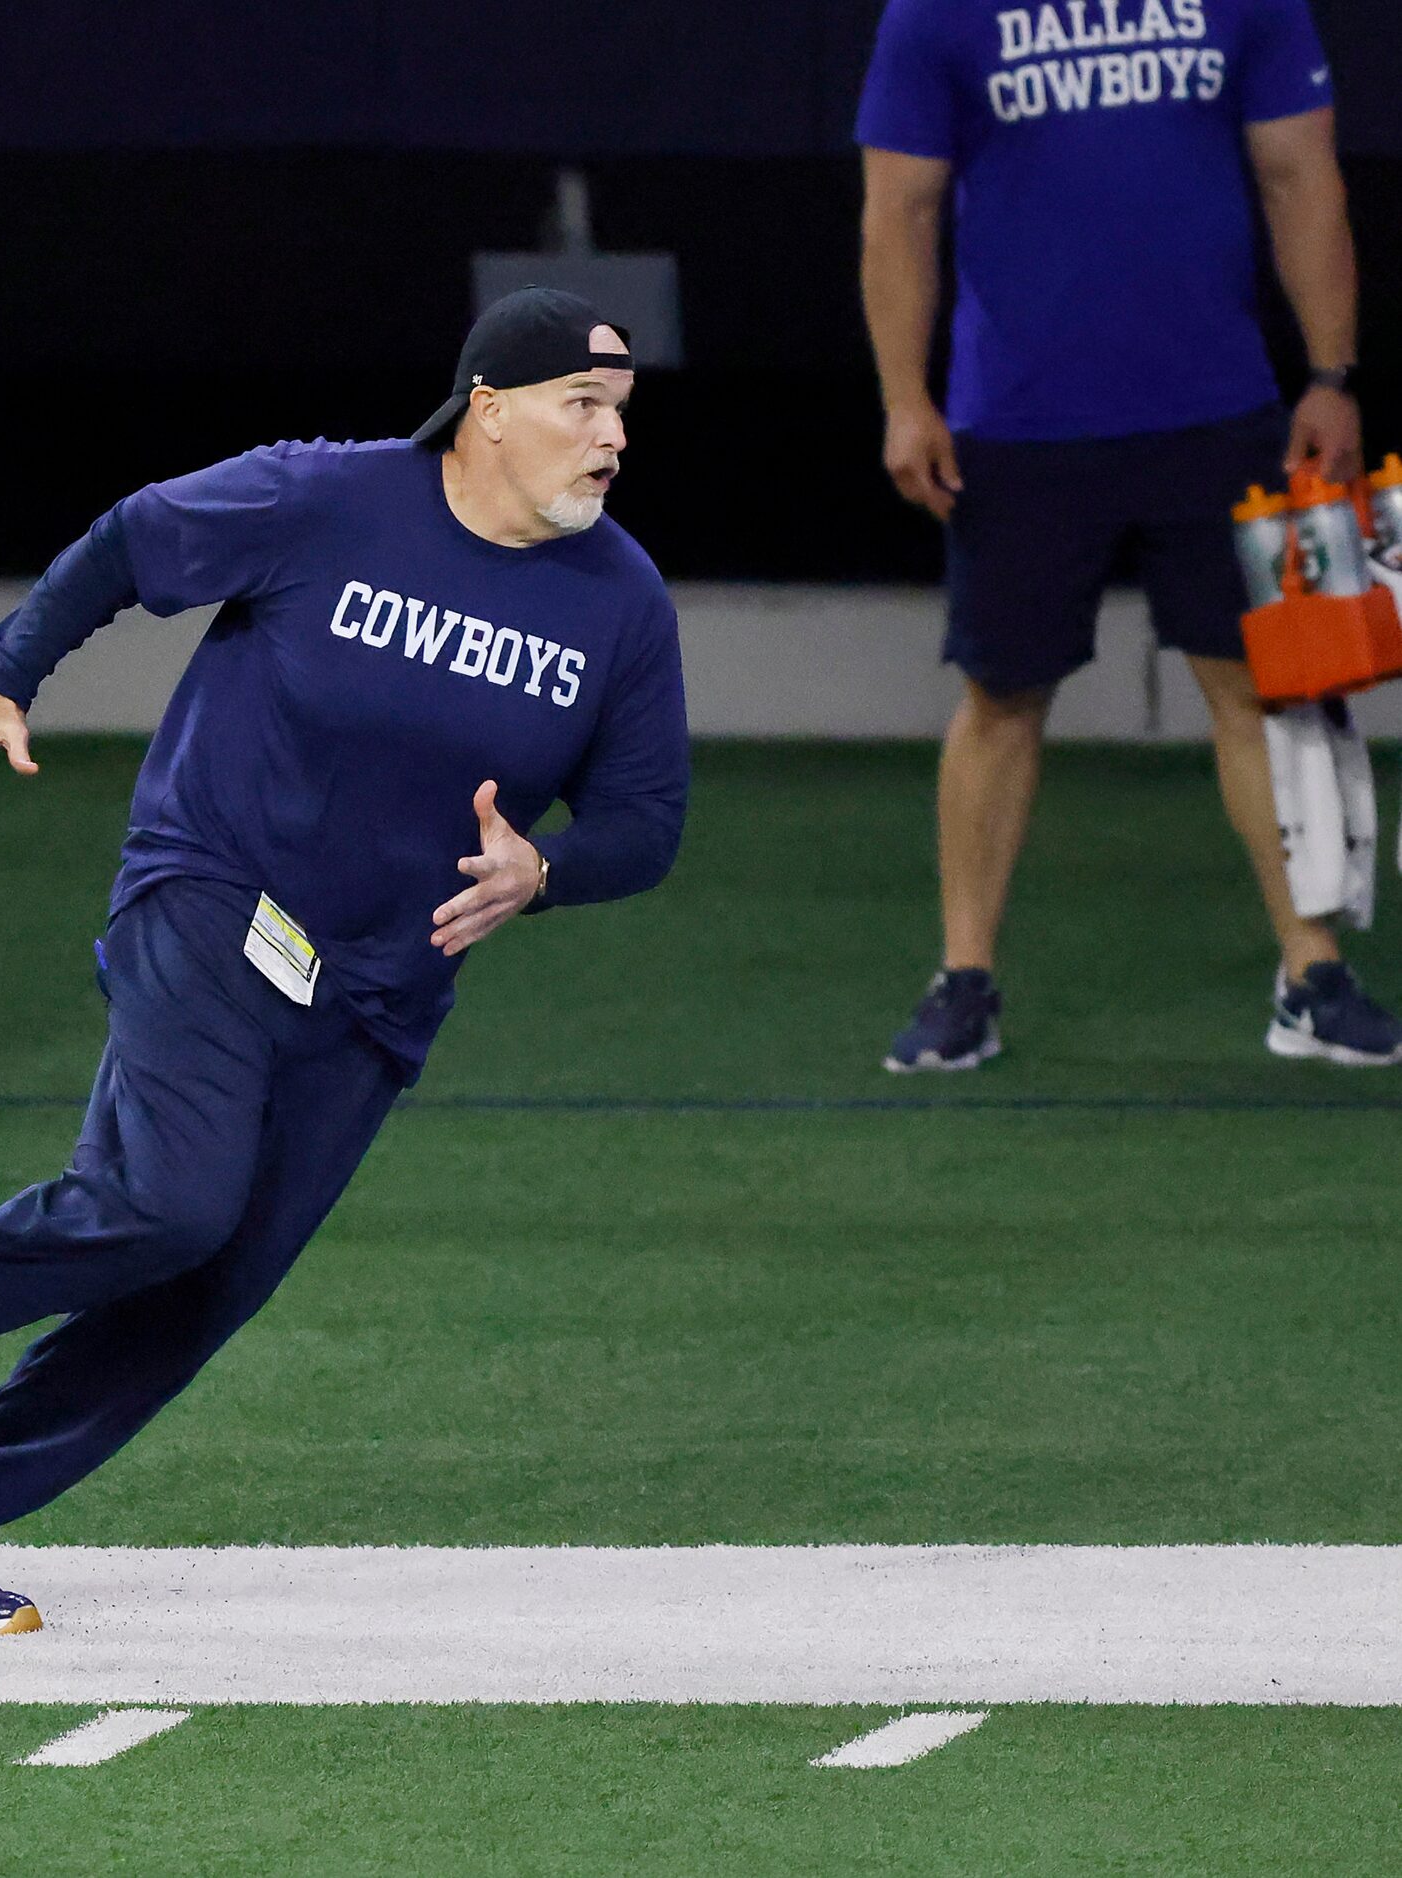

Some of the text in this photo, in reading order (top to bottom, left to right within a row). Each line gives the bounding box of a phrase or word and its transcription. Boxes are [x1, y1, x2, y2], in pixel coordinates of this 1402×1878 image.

[997, 0, 1207, 61] DALLAS
[987, 47, 1225, 122] COWBOYS
[329, 580, 587, 708] COWBOYS
